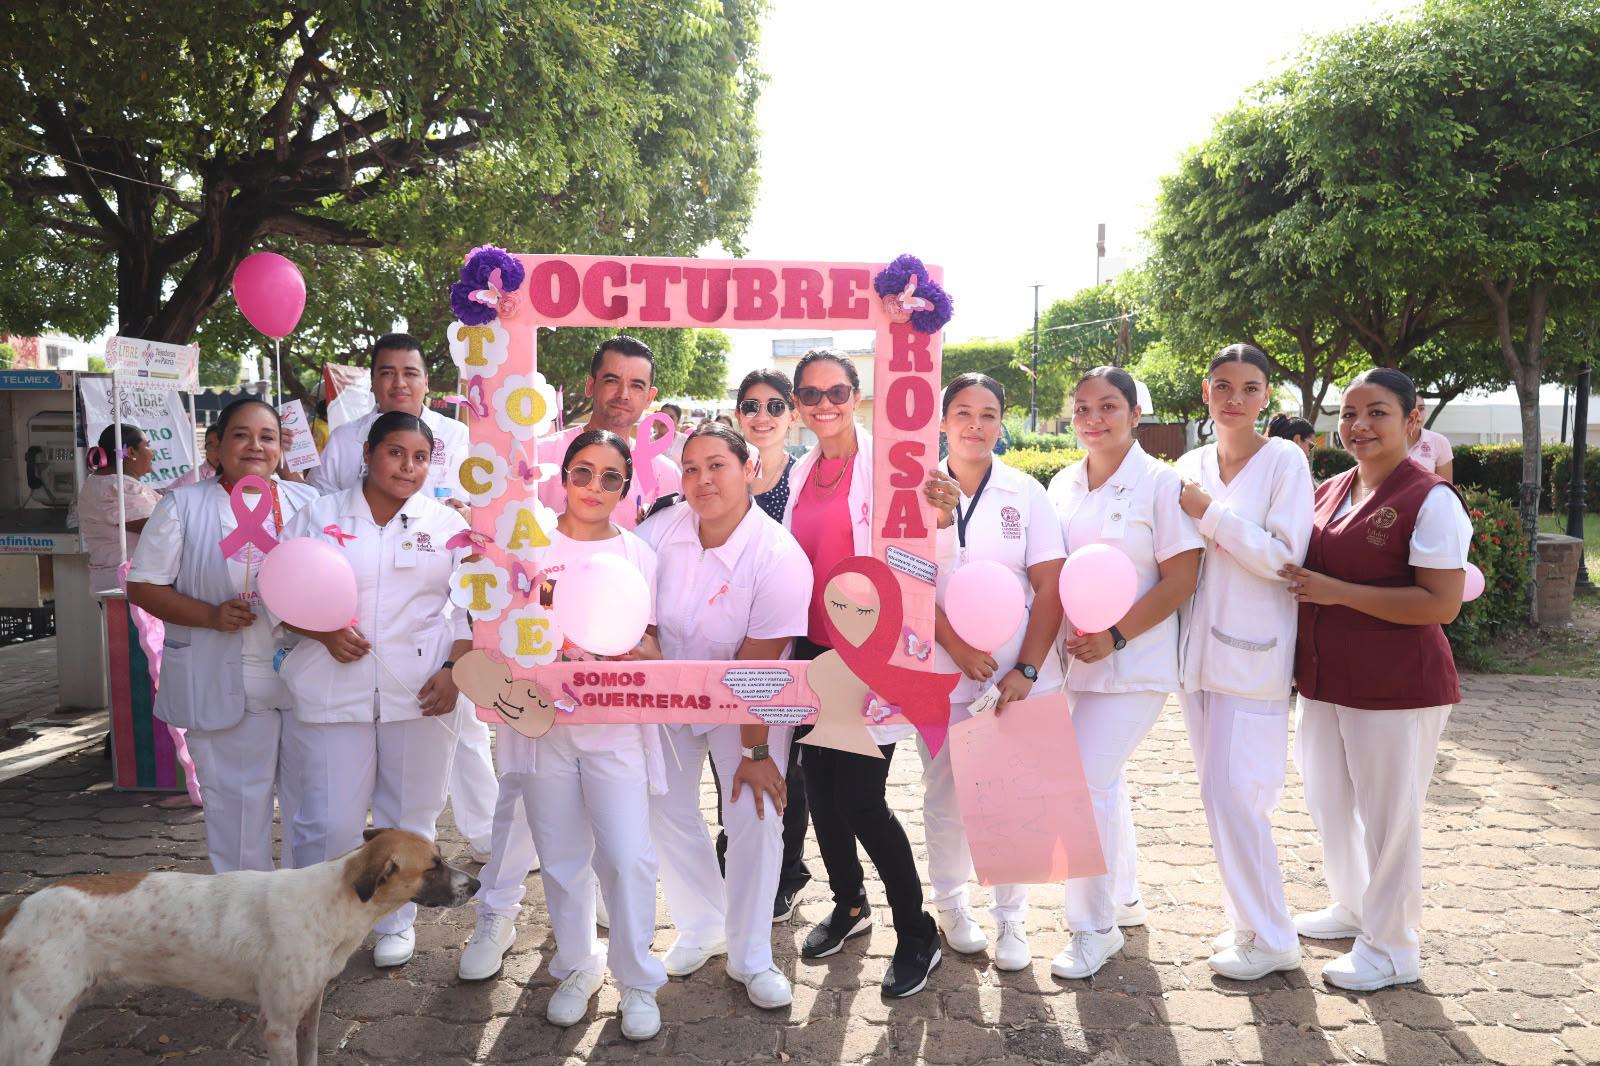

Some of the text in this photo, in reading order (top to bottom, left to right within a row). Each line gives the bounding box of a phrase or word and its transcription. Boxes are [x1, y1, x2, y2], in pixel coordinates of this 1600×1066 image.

[529, 259, 870, 322] OCTUBRE
[4, 375, 51, 384] TELMEX
[133, 392, 165, 408] LIBRE
[881, 321, 934, 539] ROSA
[457, 326, 552, 656] TOCATE
[573, 671, 646, 687] SOMOS
[582, 692, 711, 710] GUERRERAS
